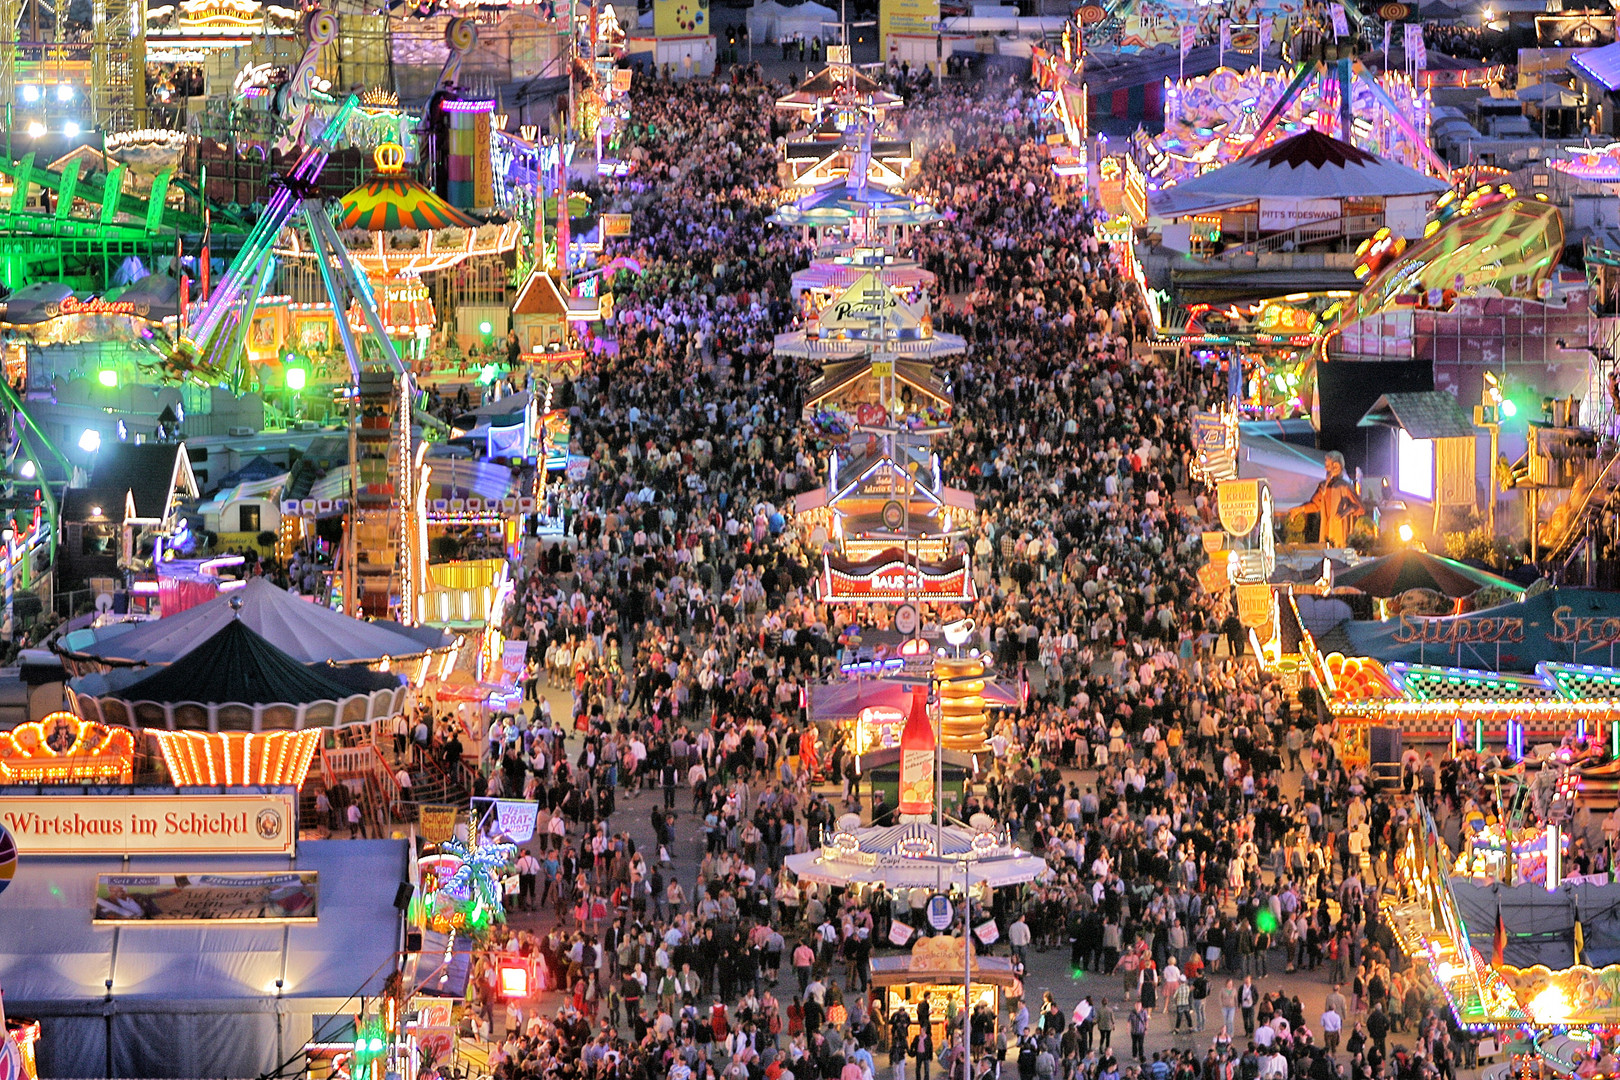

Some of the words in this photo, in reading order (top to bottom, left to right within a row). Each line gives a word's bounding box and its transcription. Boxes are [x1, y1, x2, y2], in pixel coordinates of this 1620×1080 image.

[1261, 210, 1286, 219] PITT'S
[871, 574, 924, 589] BAUSCH
[1391, 606, 1525, 655] Super
[4, 812, 123, 838] Wirtshaus
[131, 813, 157, 838] im
[164, 812, 249, 838] Schichtl
